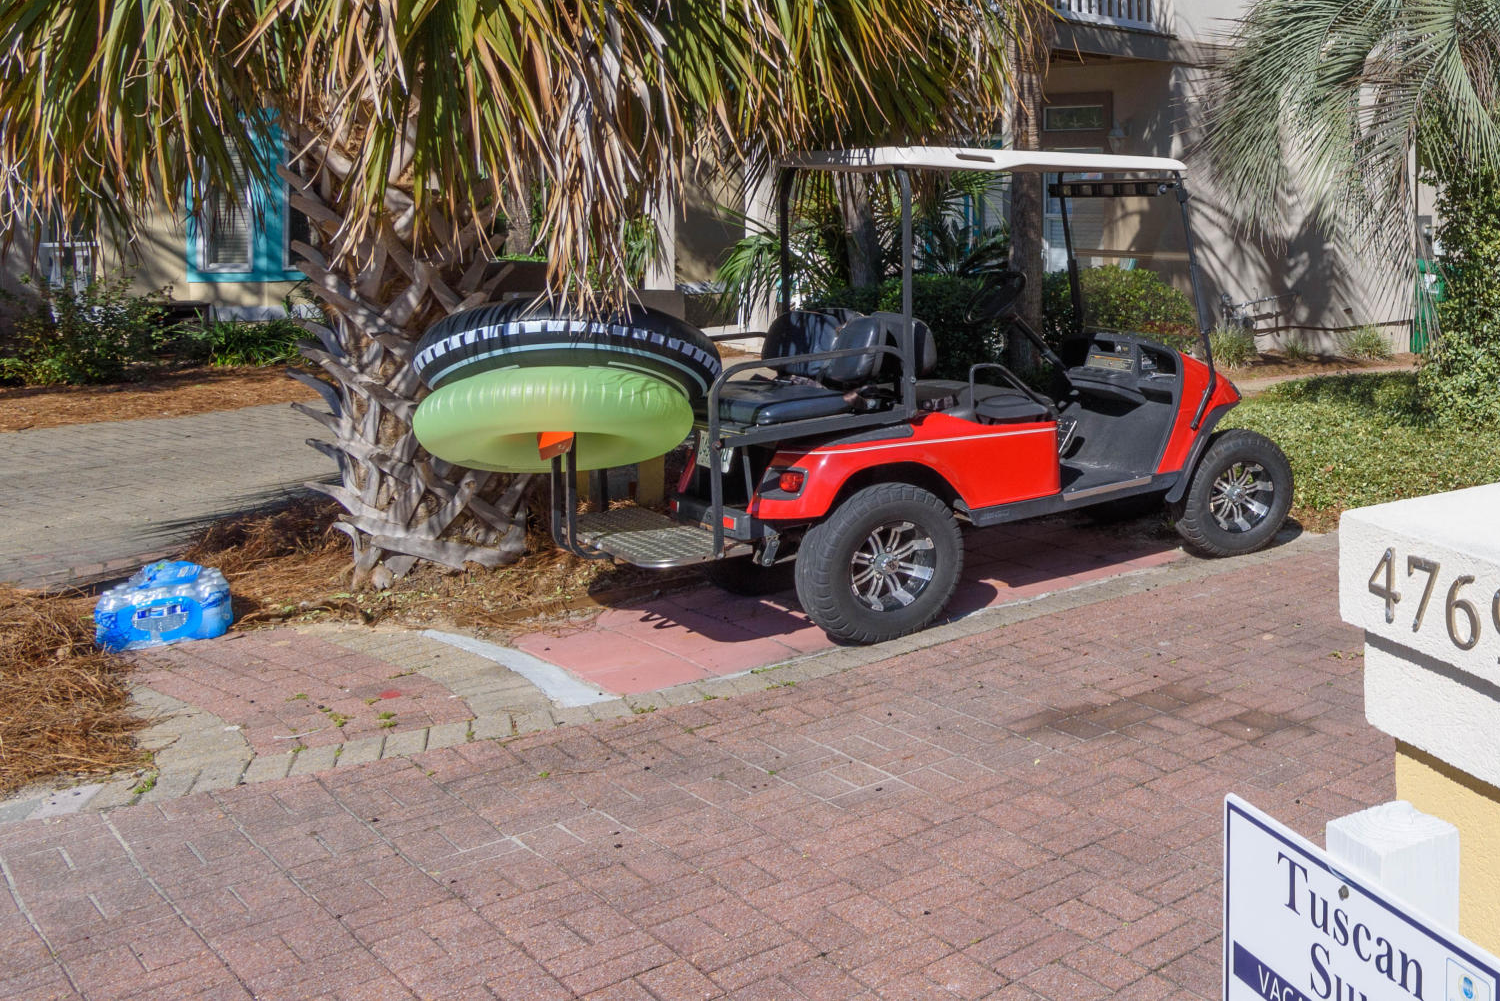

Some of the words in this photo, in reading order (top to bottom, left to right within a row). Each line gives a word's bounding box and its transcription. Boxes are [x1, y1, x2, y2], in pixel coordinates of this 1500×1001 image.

[1277, 851, 1425, 1001] Tuscan
[1257, 964, 1303, 1001] VAC
[1310, 942, 1368, 1001] Su
